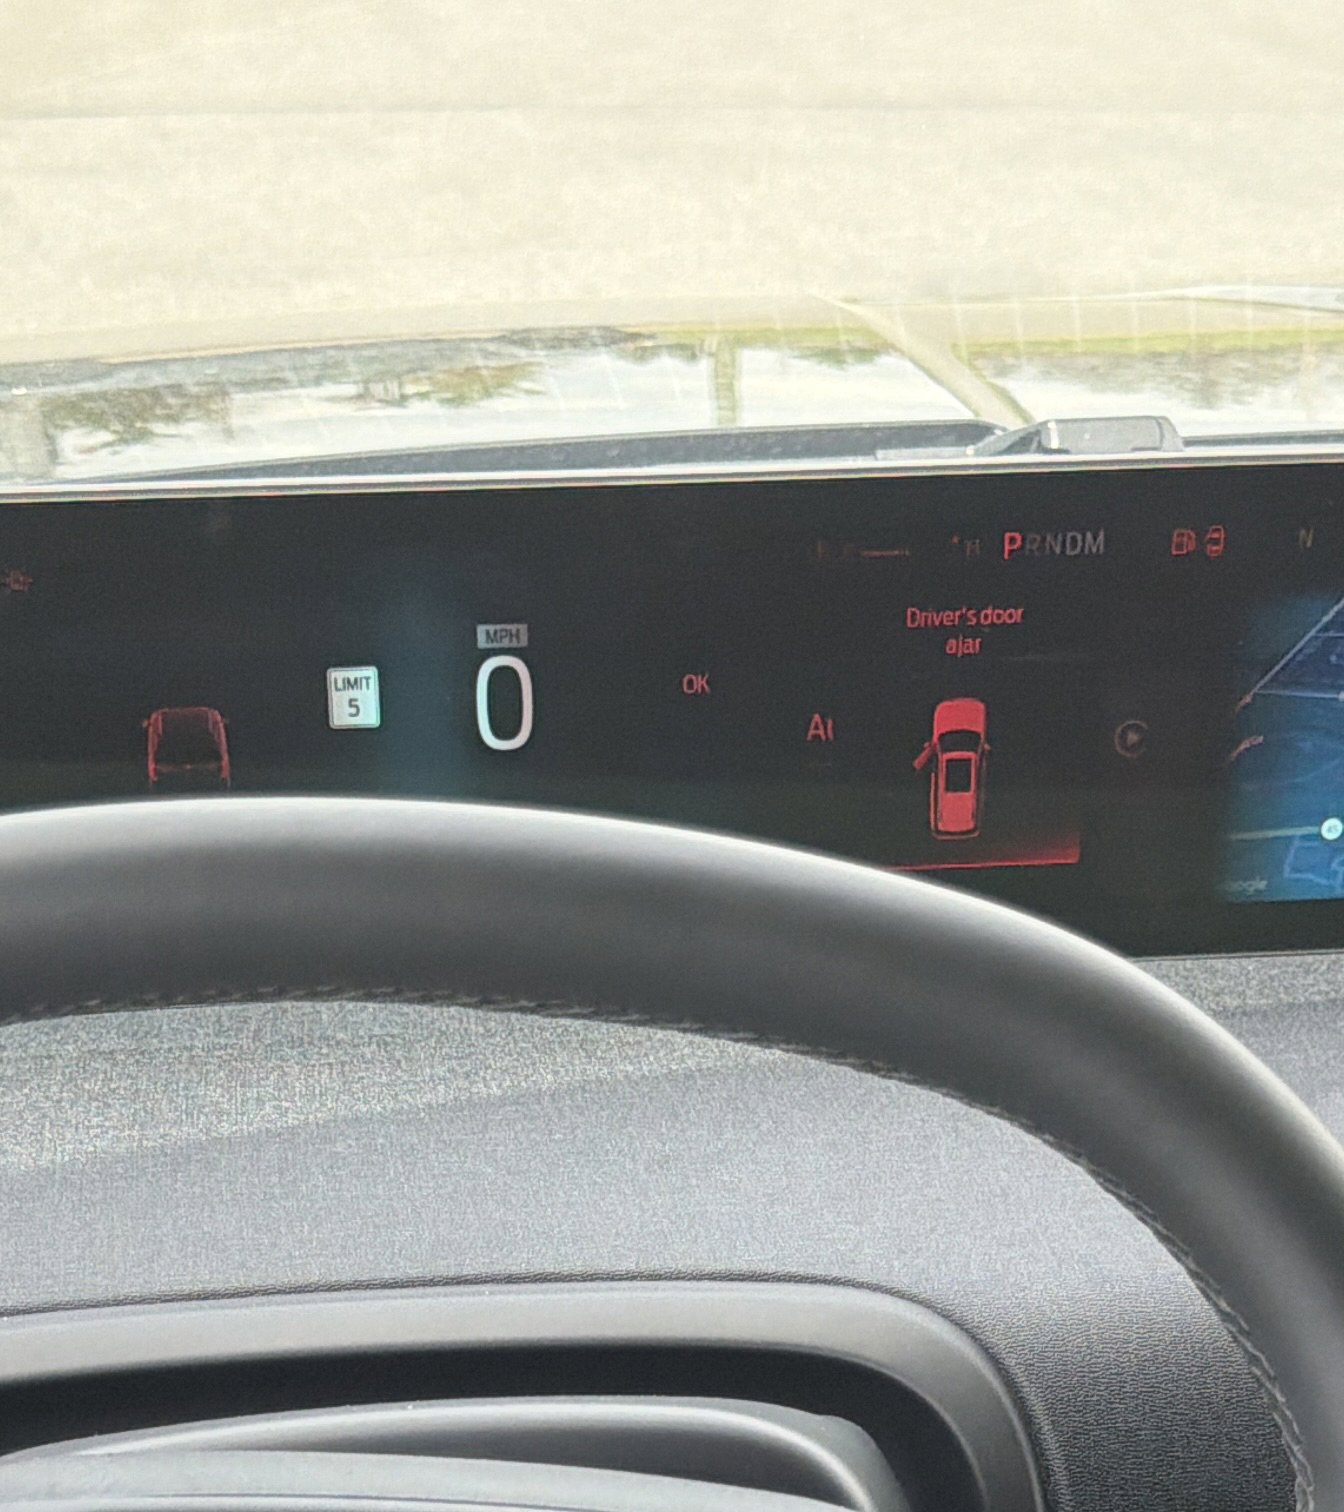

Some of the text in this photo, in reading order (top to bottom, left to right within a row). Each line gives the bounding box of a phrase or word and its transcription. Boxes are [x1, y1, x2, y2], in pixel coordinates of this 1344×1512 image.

[907, 606, 1024, 628] Driver's door
[485, 628, 520, 645] MPH
[946, 635, 981, 657] ajar
[333, 676, 371, 692] LIMIT
[682, 673, 711, 694] OK
[347, 698, 361, 718] 5
[476, 655, 534, 751] 0
